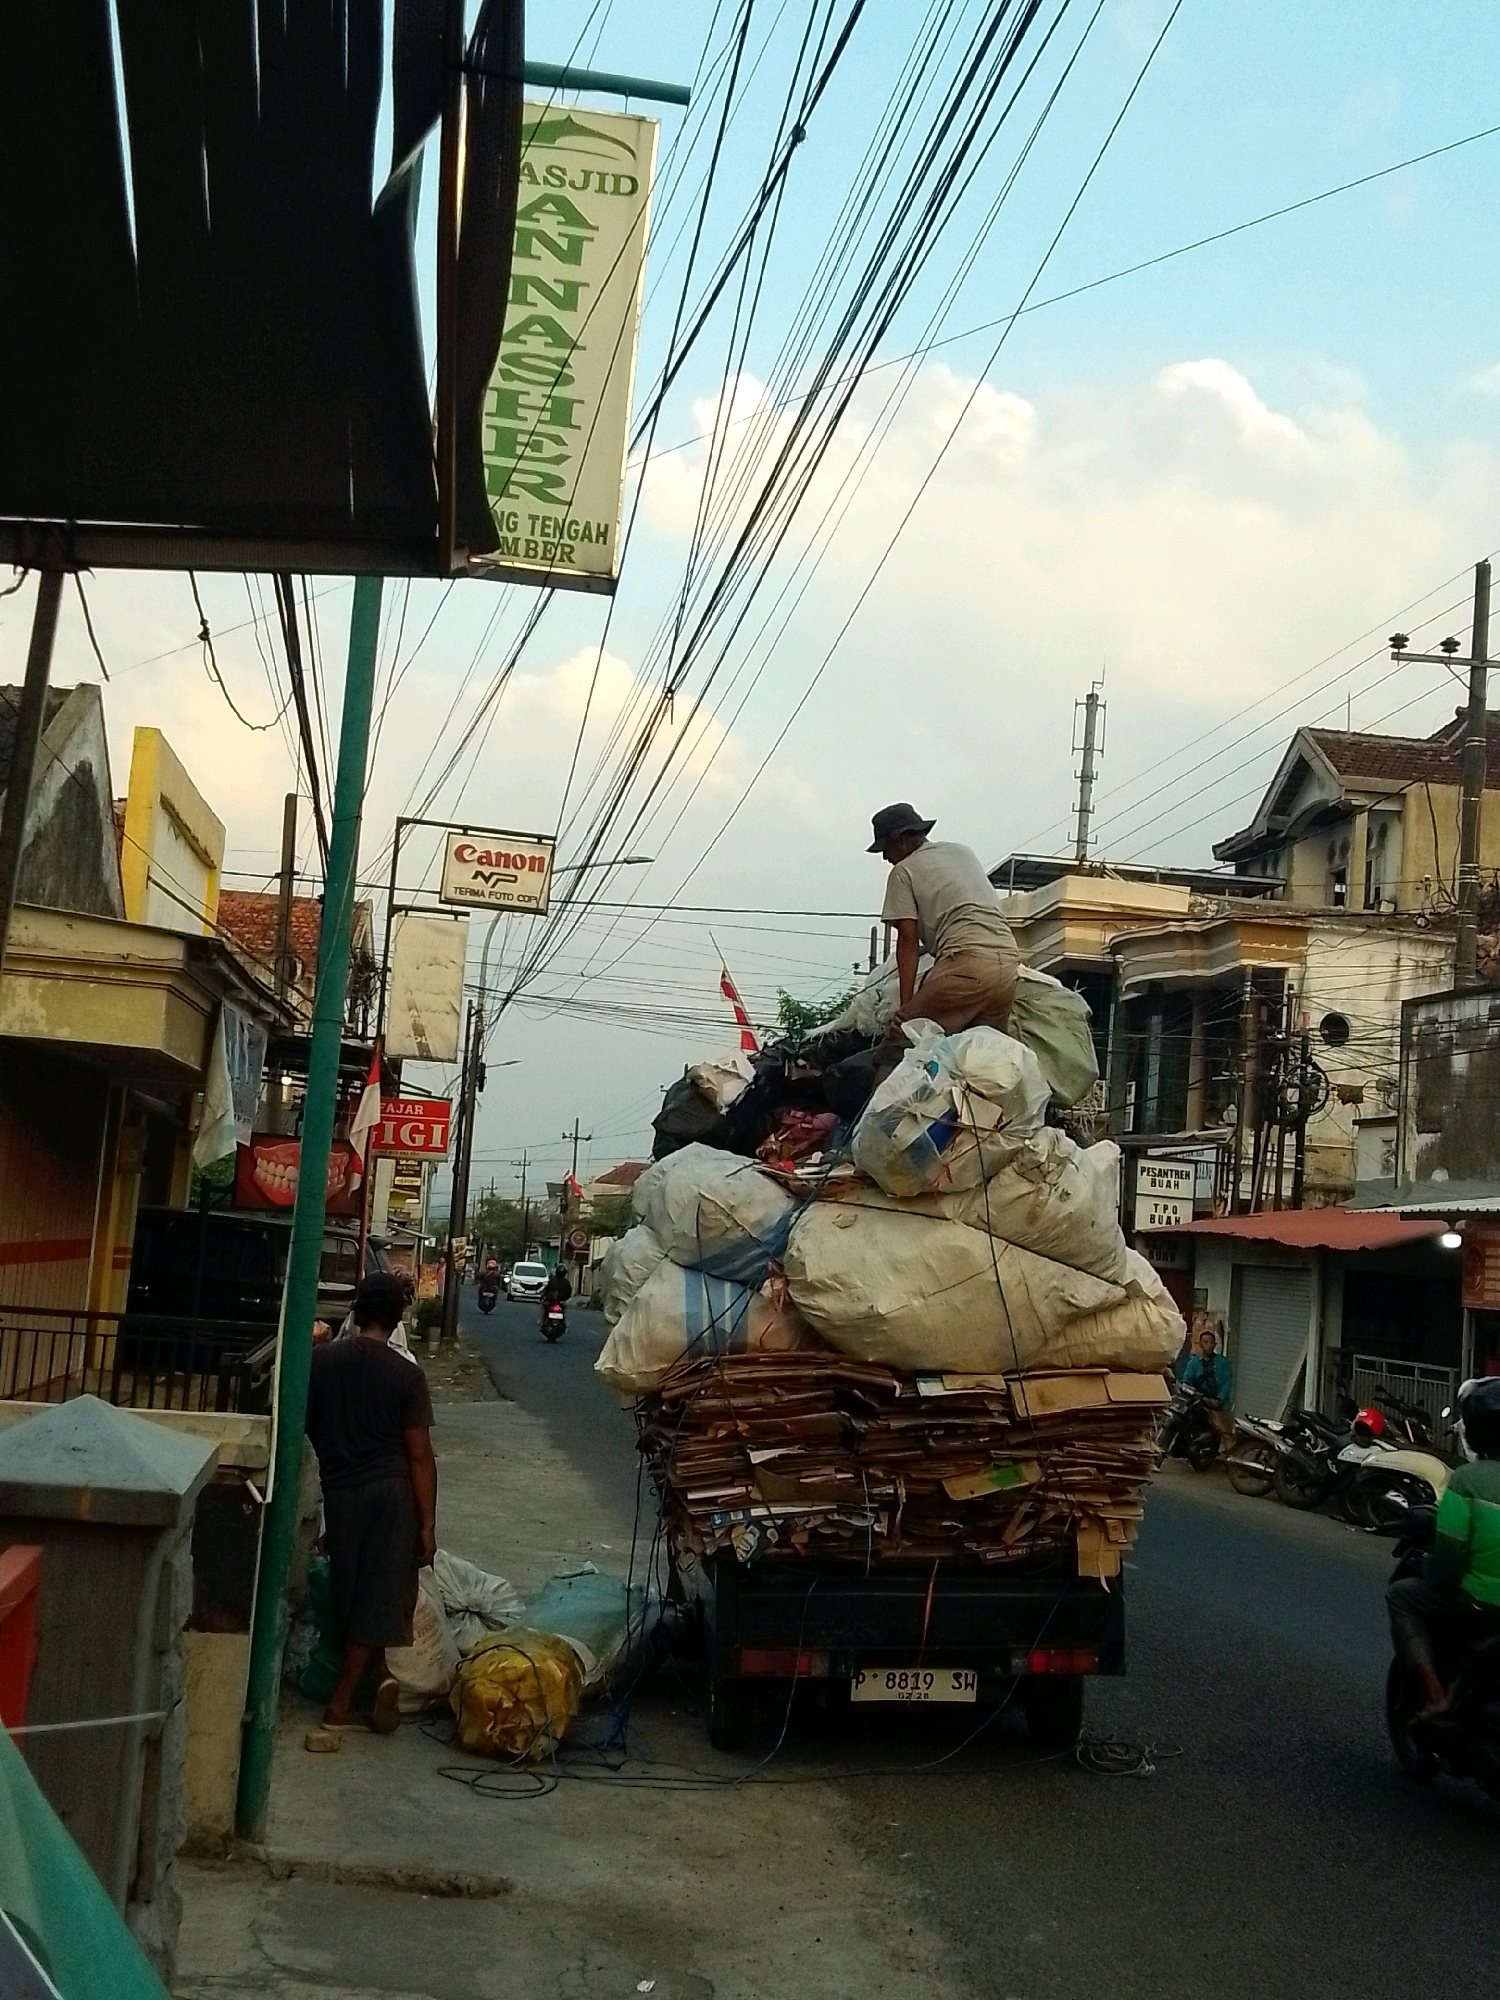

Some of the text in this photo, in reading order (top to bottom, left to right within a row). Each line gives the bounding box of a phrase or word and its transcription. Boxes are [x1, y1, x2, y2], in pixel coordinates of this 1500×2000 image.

[527, 513, 610, 546] TENGAH
[453, 843, 546, 873] Canon
[487, 891, 514, 901] FOTO
[372, 1120, 446, 1148] IGI
[1140, 1165, 1191, 1180] PESANTREN
[1150, 1178, 1180, 1190] BUAH
[1149, 1213, 1181, 1226] BUAH
[854, 1671, 976, 1690] P 8819 SW
